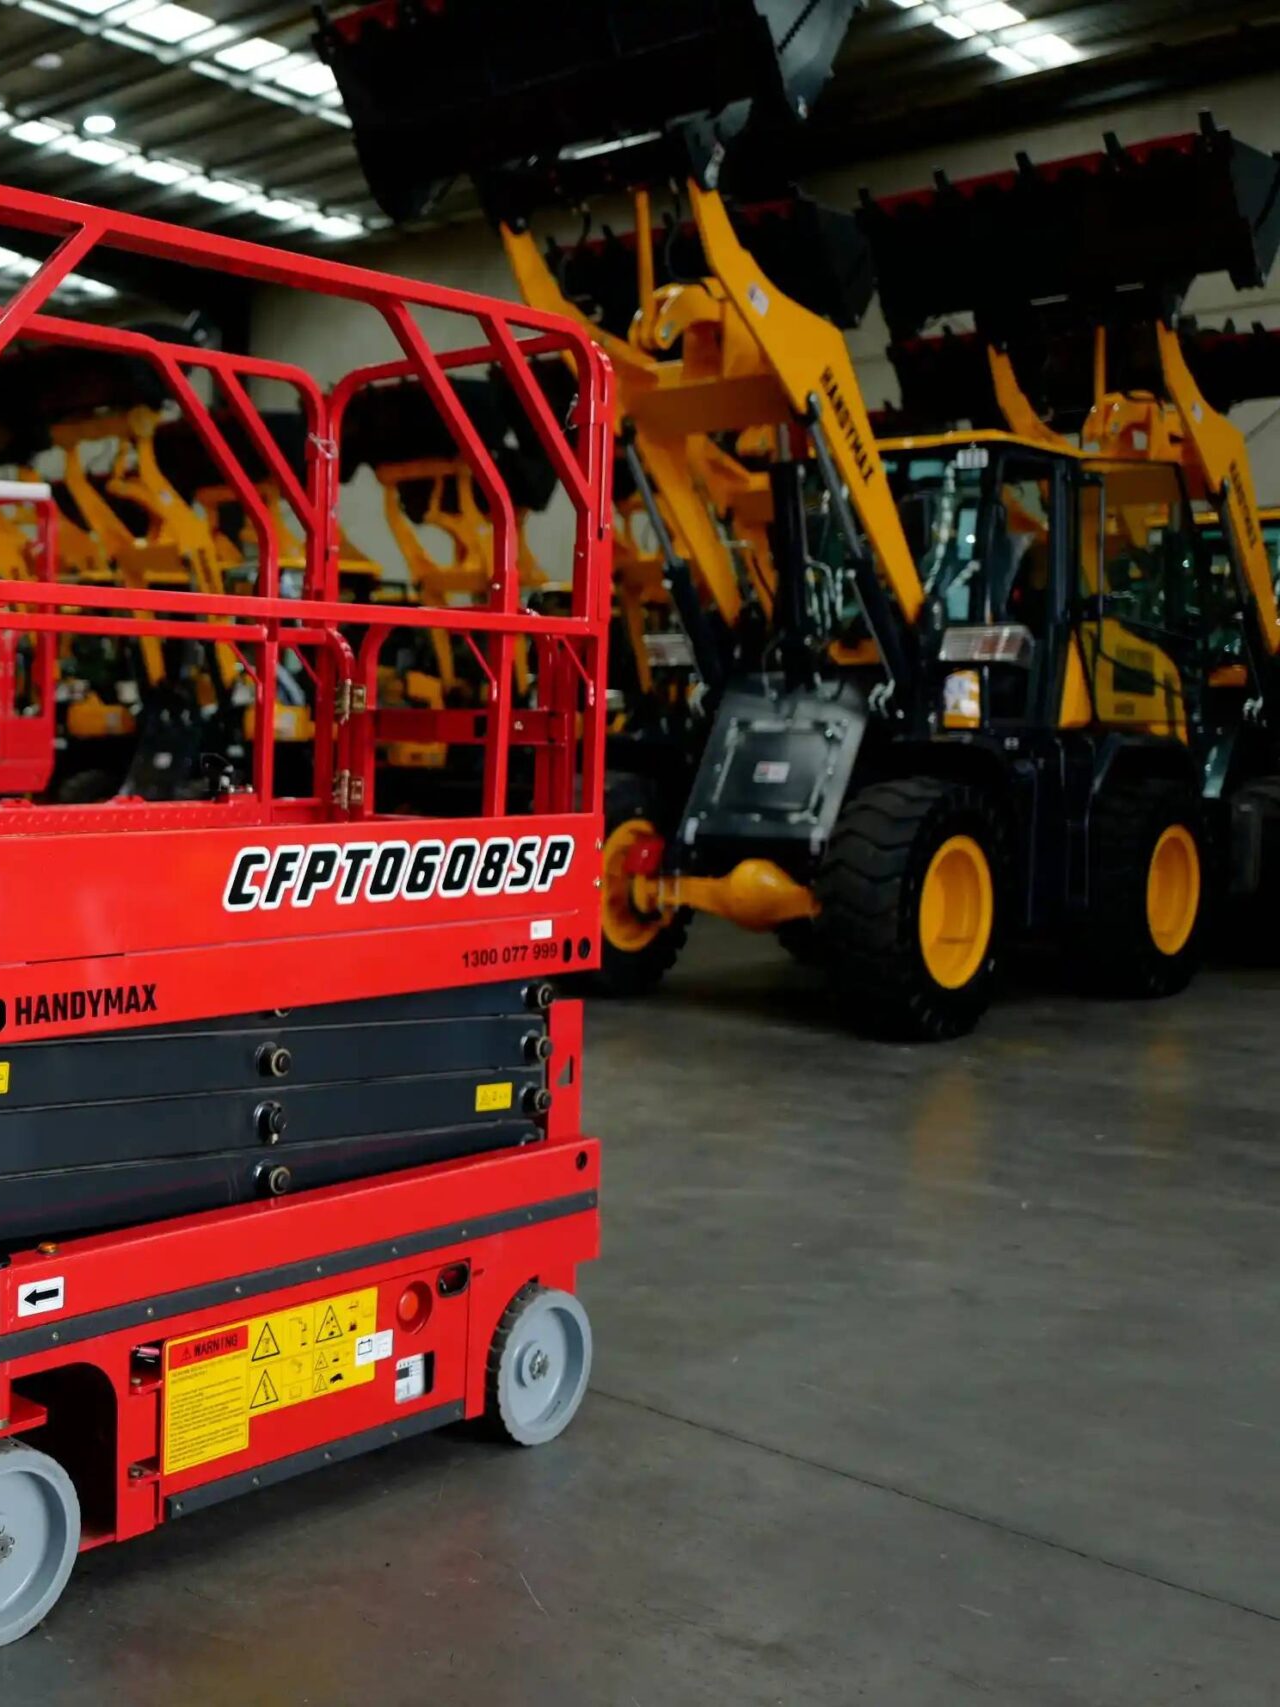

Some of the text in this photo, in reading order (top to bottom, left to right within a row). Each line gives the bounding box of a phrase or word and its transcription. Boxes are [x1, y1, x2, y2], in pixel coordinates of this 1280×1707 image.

[223, 836, 574, 911] CFPT0608SP
[461, 942, 559, 968] 1300 077 999
[14, 983, 158, 1027] HANDYMAX
[193, 1333, 239, 1357] WARNING
